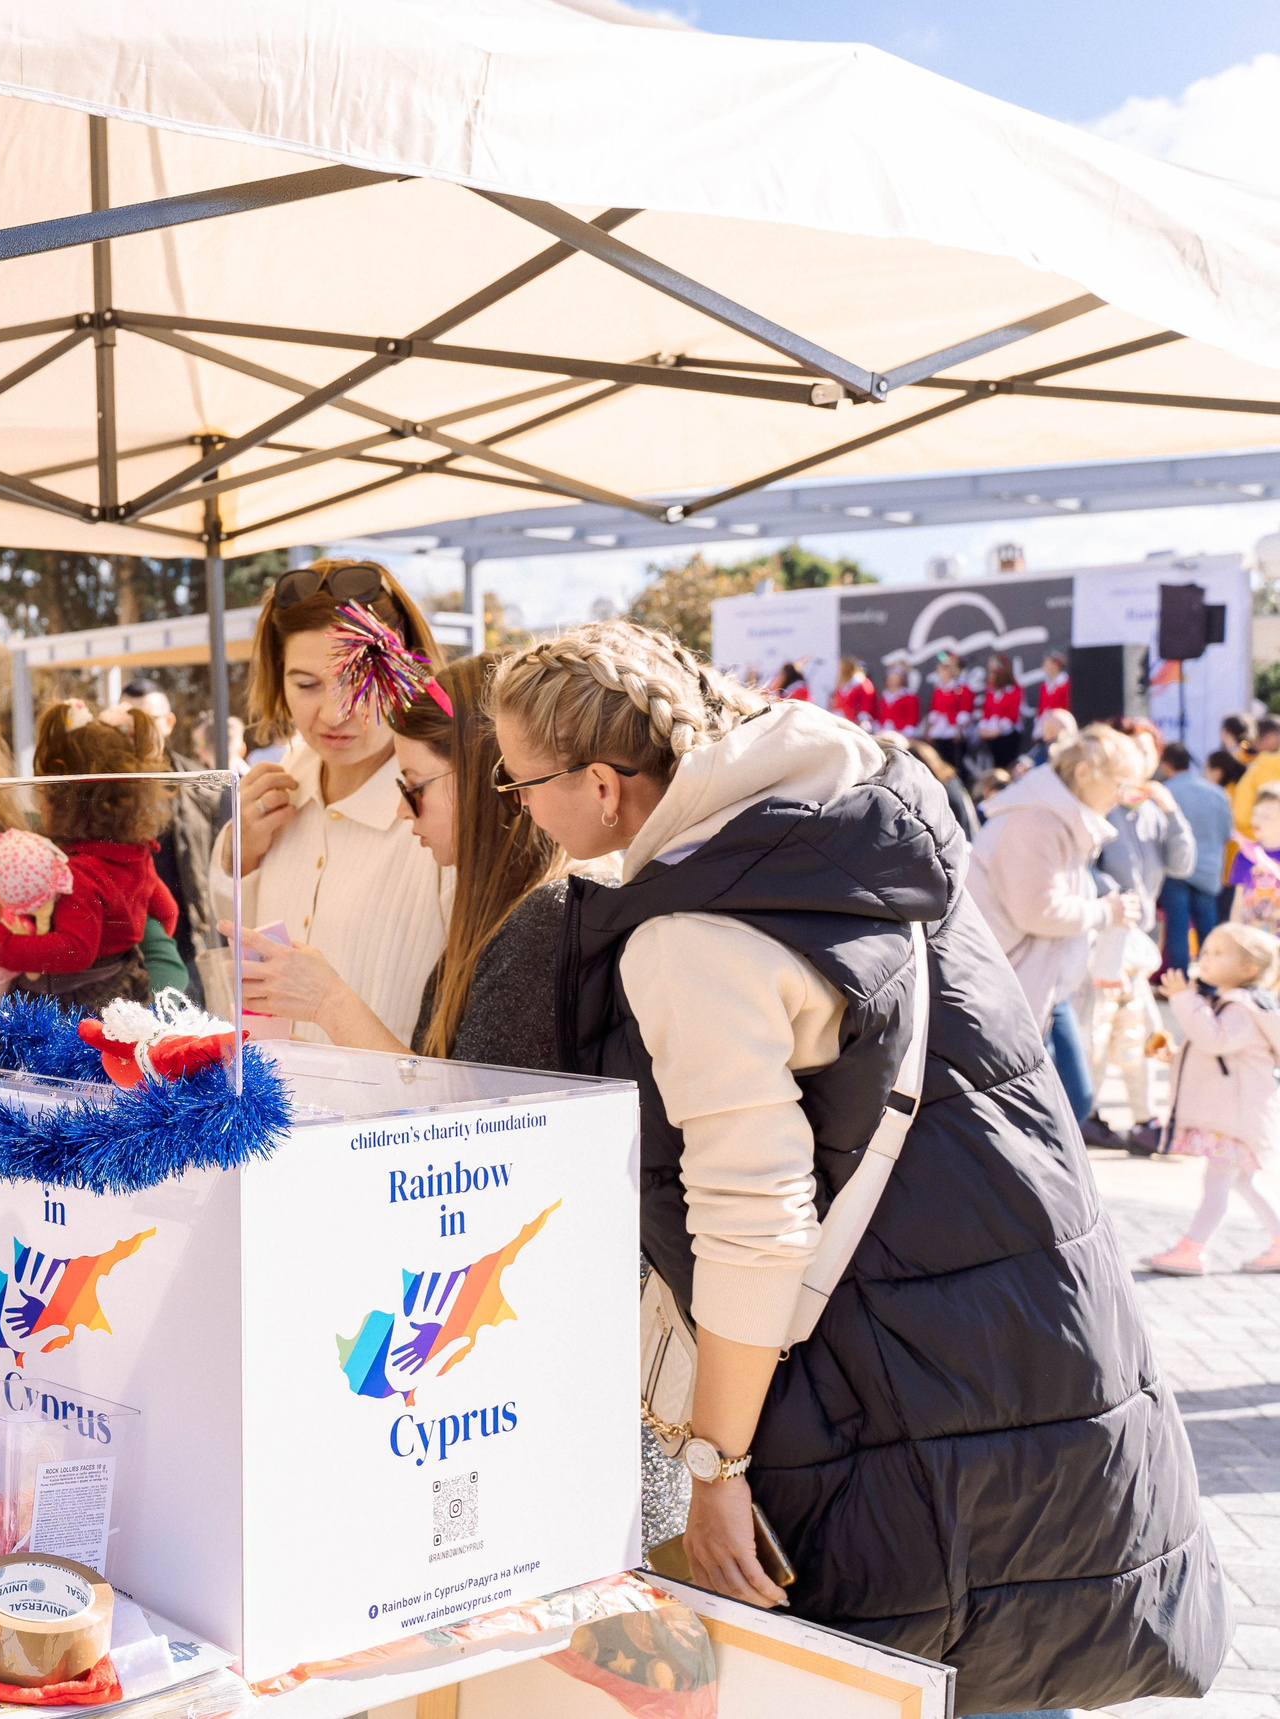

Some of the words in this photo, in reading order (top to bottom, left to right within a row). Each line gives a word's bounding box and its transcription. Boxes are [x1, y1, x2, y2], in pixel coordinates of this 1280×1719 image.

[350, 1125, 420, 1151] children's
[423, 1121, 472, 1141] charity
[475, 1112, 547, 1135] foundation
[388, 1160, 513, 1204] Rainbow
[43, 1190, 67, 1227] in
[439, 1204, 467, 1238] in
[389, 1401, 518, 1467] Cyprus
[60, 1465, 79, 1474] LOLLIES
[428, 1540, 485, 1564] @RAINBOWINCYPRUS
[381, 1594, 422, 1614] Rainbow
[423, 1591, 432, 1602] in
[434, 1572, 498, 1599] Cyprus/Радуга
[500, 1568, 511, 1578] на
[513, 1560, 541, 1576] Кипре
[9, 1602, 68, 1618] UNIVERSAL
[400, 1588, 512, 1629] www.rainbowcyprus.com
